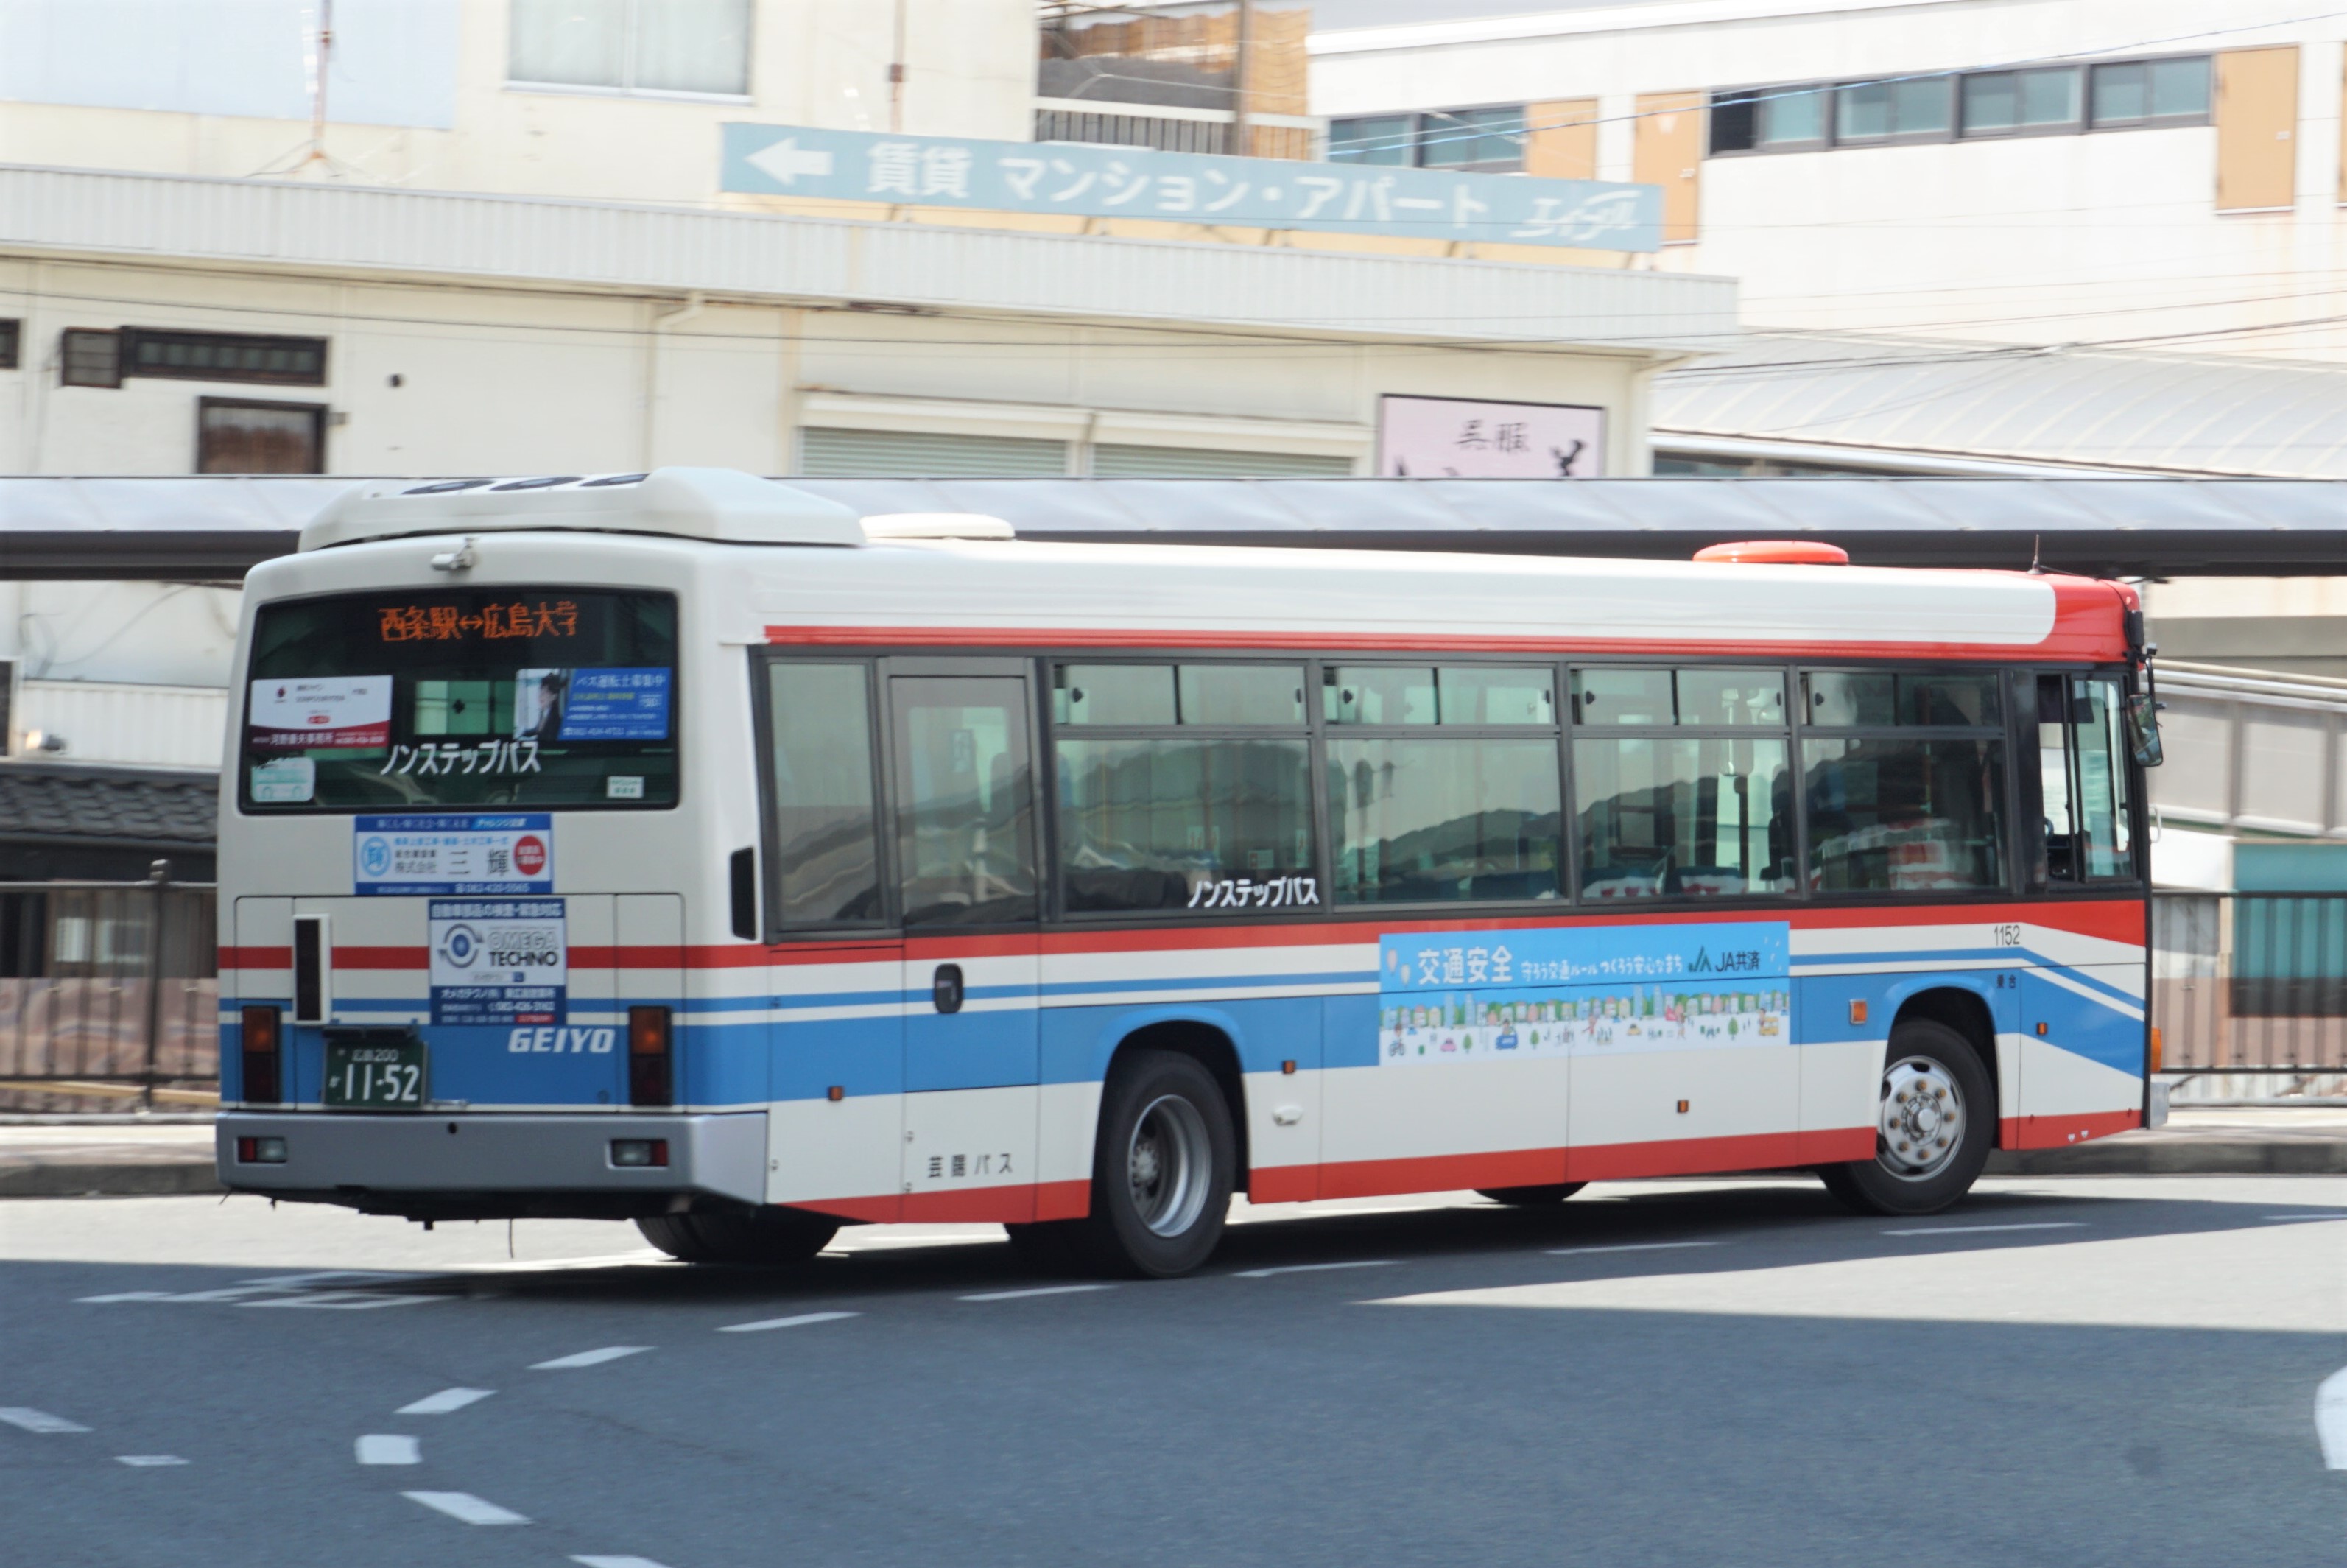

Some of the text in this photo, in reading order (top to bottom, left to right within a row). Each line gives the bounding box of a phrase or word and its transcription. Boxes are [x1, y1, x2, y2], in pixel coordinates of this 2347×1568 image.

[867, 141, 974, 199] 賃貸
[997, 156, 1489, 230] マンション・アパート
[1454, 419, 1530, 454] 呉服
[379, 608, 462, 641] 西条駅
[379, 740, 543, 776] ノンステップバス
[1187, 876, 1320, 910] ノンステップバス
[488, 930, 559, 950] OMEGA
[1994, 925, 2020, 946] 1152
[489, 950, 559, 967] TECHNO
[1418, 945, 1513, 985] 交通安全
[1521, 960, 1597, 982] 守ろう交通ルール
[1600, 953, 1683, 975] つくろう安心なまち
[1715, 950, 1761, 973] JA共済
[507, 1028, 616, 1054] GEIYO
[345, 1064, 421, 1102] 11-52
[928, 1153, 1013, 1178] 芸陽バス
